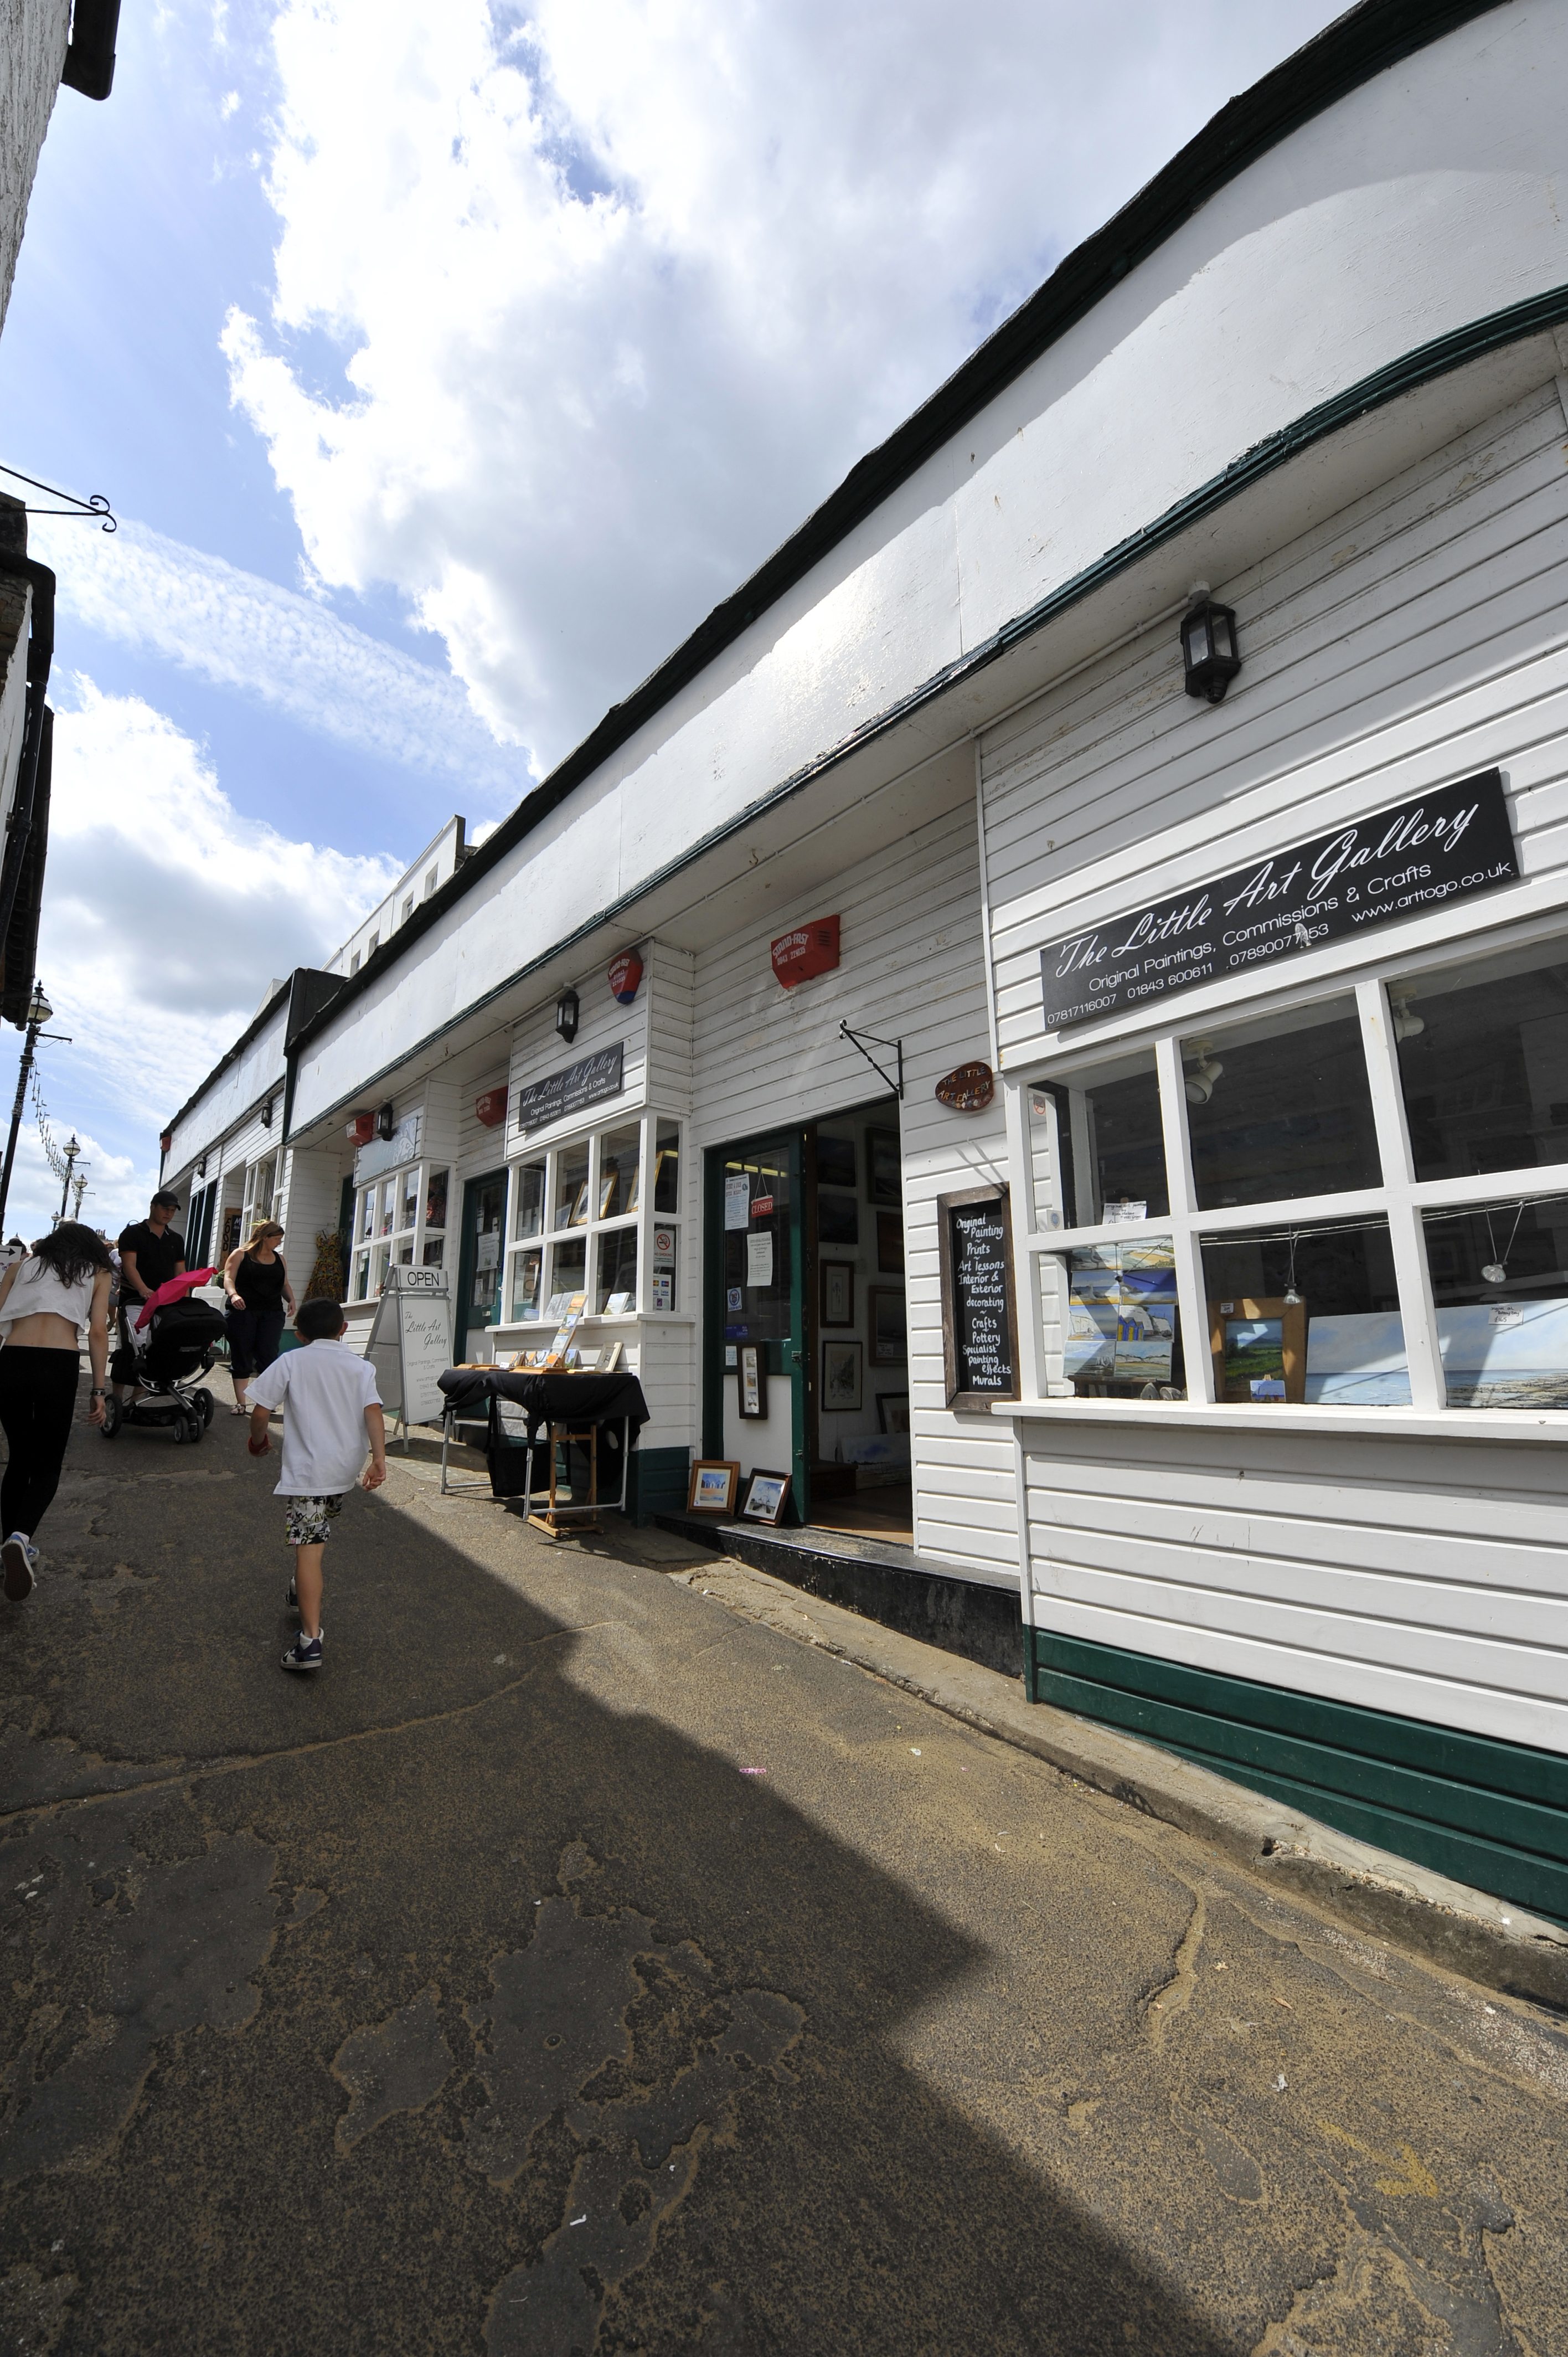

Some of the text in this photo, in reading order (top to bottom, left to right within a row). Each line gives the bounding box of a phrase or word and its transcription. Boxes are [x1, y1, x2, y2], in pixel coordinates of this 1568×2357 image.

[1055, 804, 1479, 977] The Little Art Gallery
[1089, 864, 1431, 991] Original Paintings, Commissions & Crafts
[772, 933, 809, 959] STAND-FAST
[1048, 994, 1117, 1024] 07817116007
[1127, 979, 1164, 999] 01843
[1168, 963, 1213, 985] 600611
[1352, 862, 1512, 922] www.arttogo.co.uk
[523, 1053, 617, 1107] The Little Art Gallery
[942, 1066, 986, 1085] THE LITTLE
[530, 1104, 544, 1116] Original
[563, 1086, 587, 1102] Commissions
[592, 1078, 606, 1088] Crafts
[937, 1090, 956, 1101] ART
[751, 1201, 773, 1215] CLOSED
[956, 1212, 986, 1234] Original
[971, 1224, 1003, 1240] Painting
[967, 1242, 991, 1256] Prints
[957, 1259, 1005, 1272] Art lessons
[407, 1272, 440, 1286] OPEN
[958, 1270, 999, 1285] Interior &
[971, 1283, 1003, 1294] Exterior
[966, 1296, 1004, 1313] decorating
[405, 1319, 441, 1334] Little Art
[972, 1316, 997, 1330] Crafts
[423, 1333, 447, 1351] Gallery
[972, 1331, 1000, 1346] Pottery
[962, 1344, 997, 1356] Specialist
[982, 1363, 1012, 1376] effects
[972, 1375, 1002, 1386] Murals
